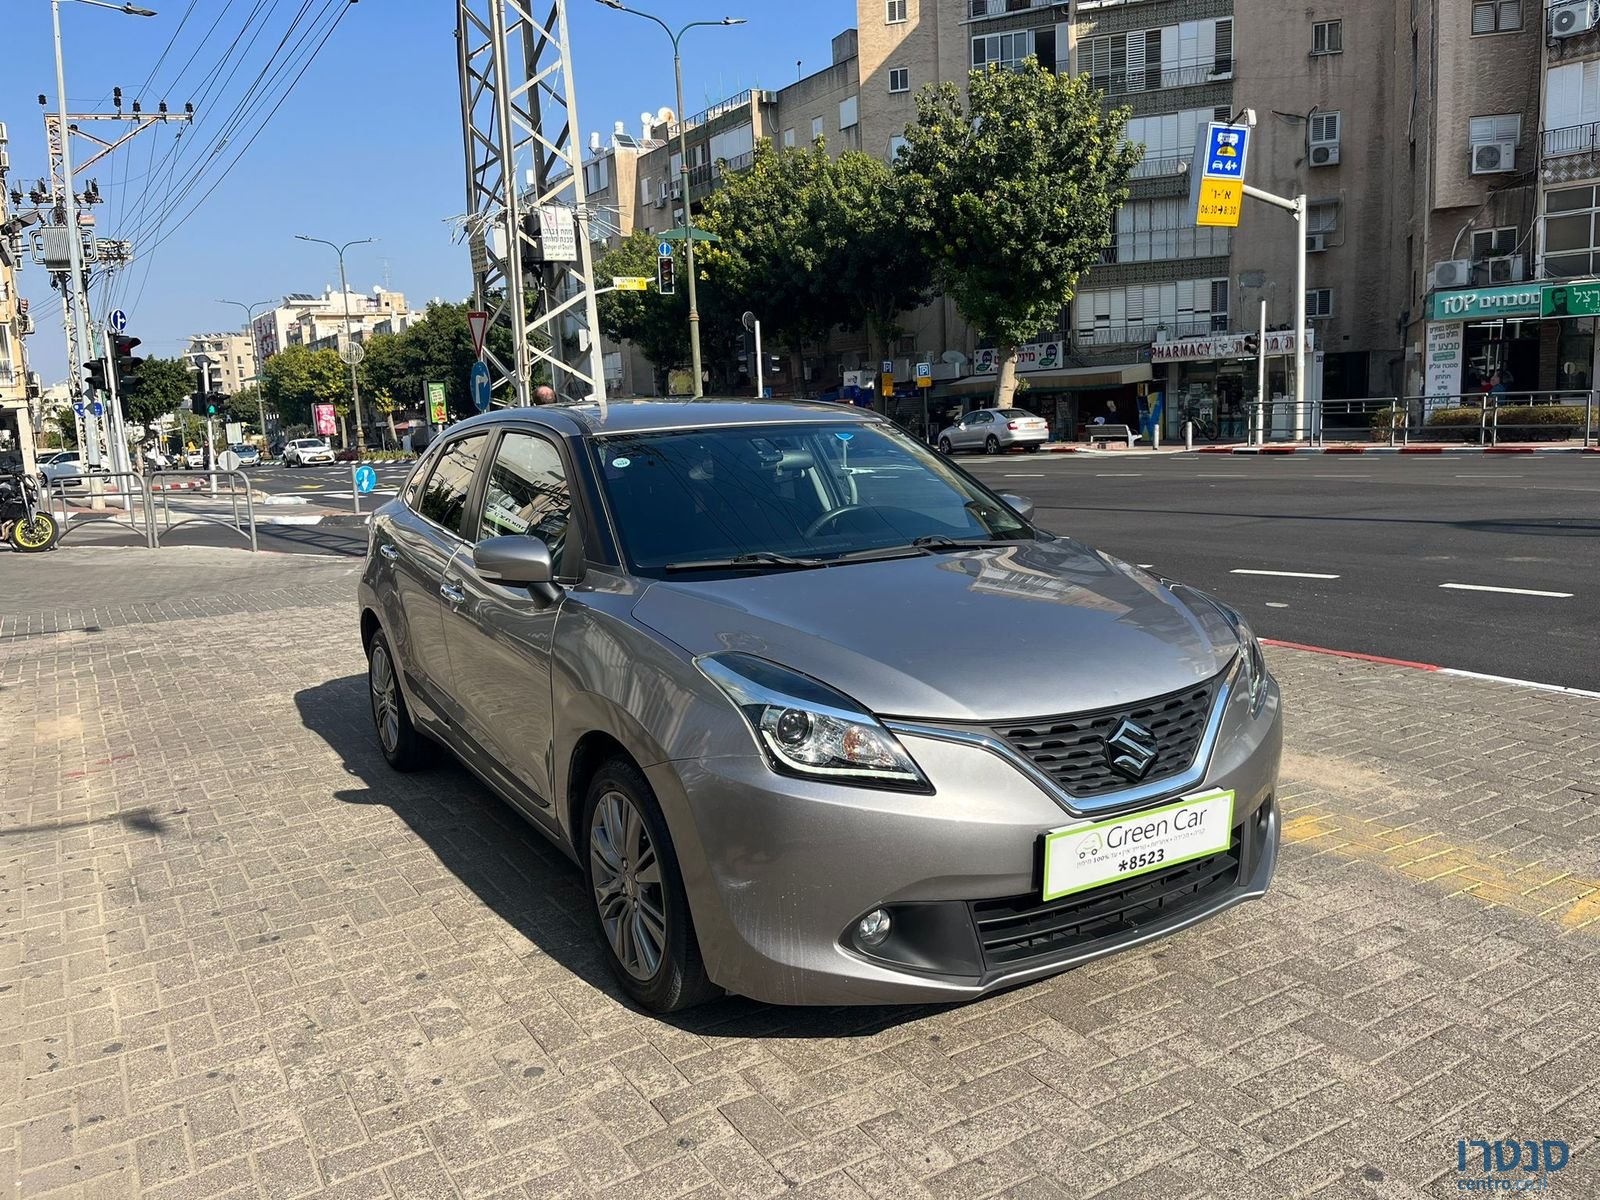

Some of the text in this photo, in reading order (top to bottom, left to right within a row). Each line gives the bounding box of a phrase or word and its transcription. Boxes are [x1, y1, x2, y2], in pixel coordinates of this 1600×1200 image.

[1440, 293, 1477, 314] TOP
[1151, 342, 1212, 358] PHARMACY
[1106, 808, 1209, 849] Green Car
